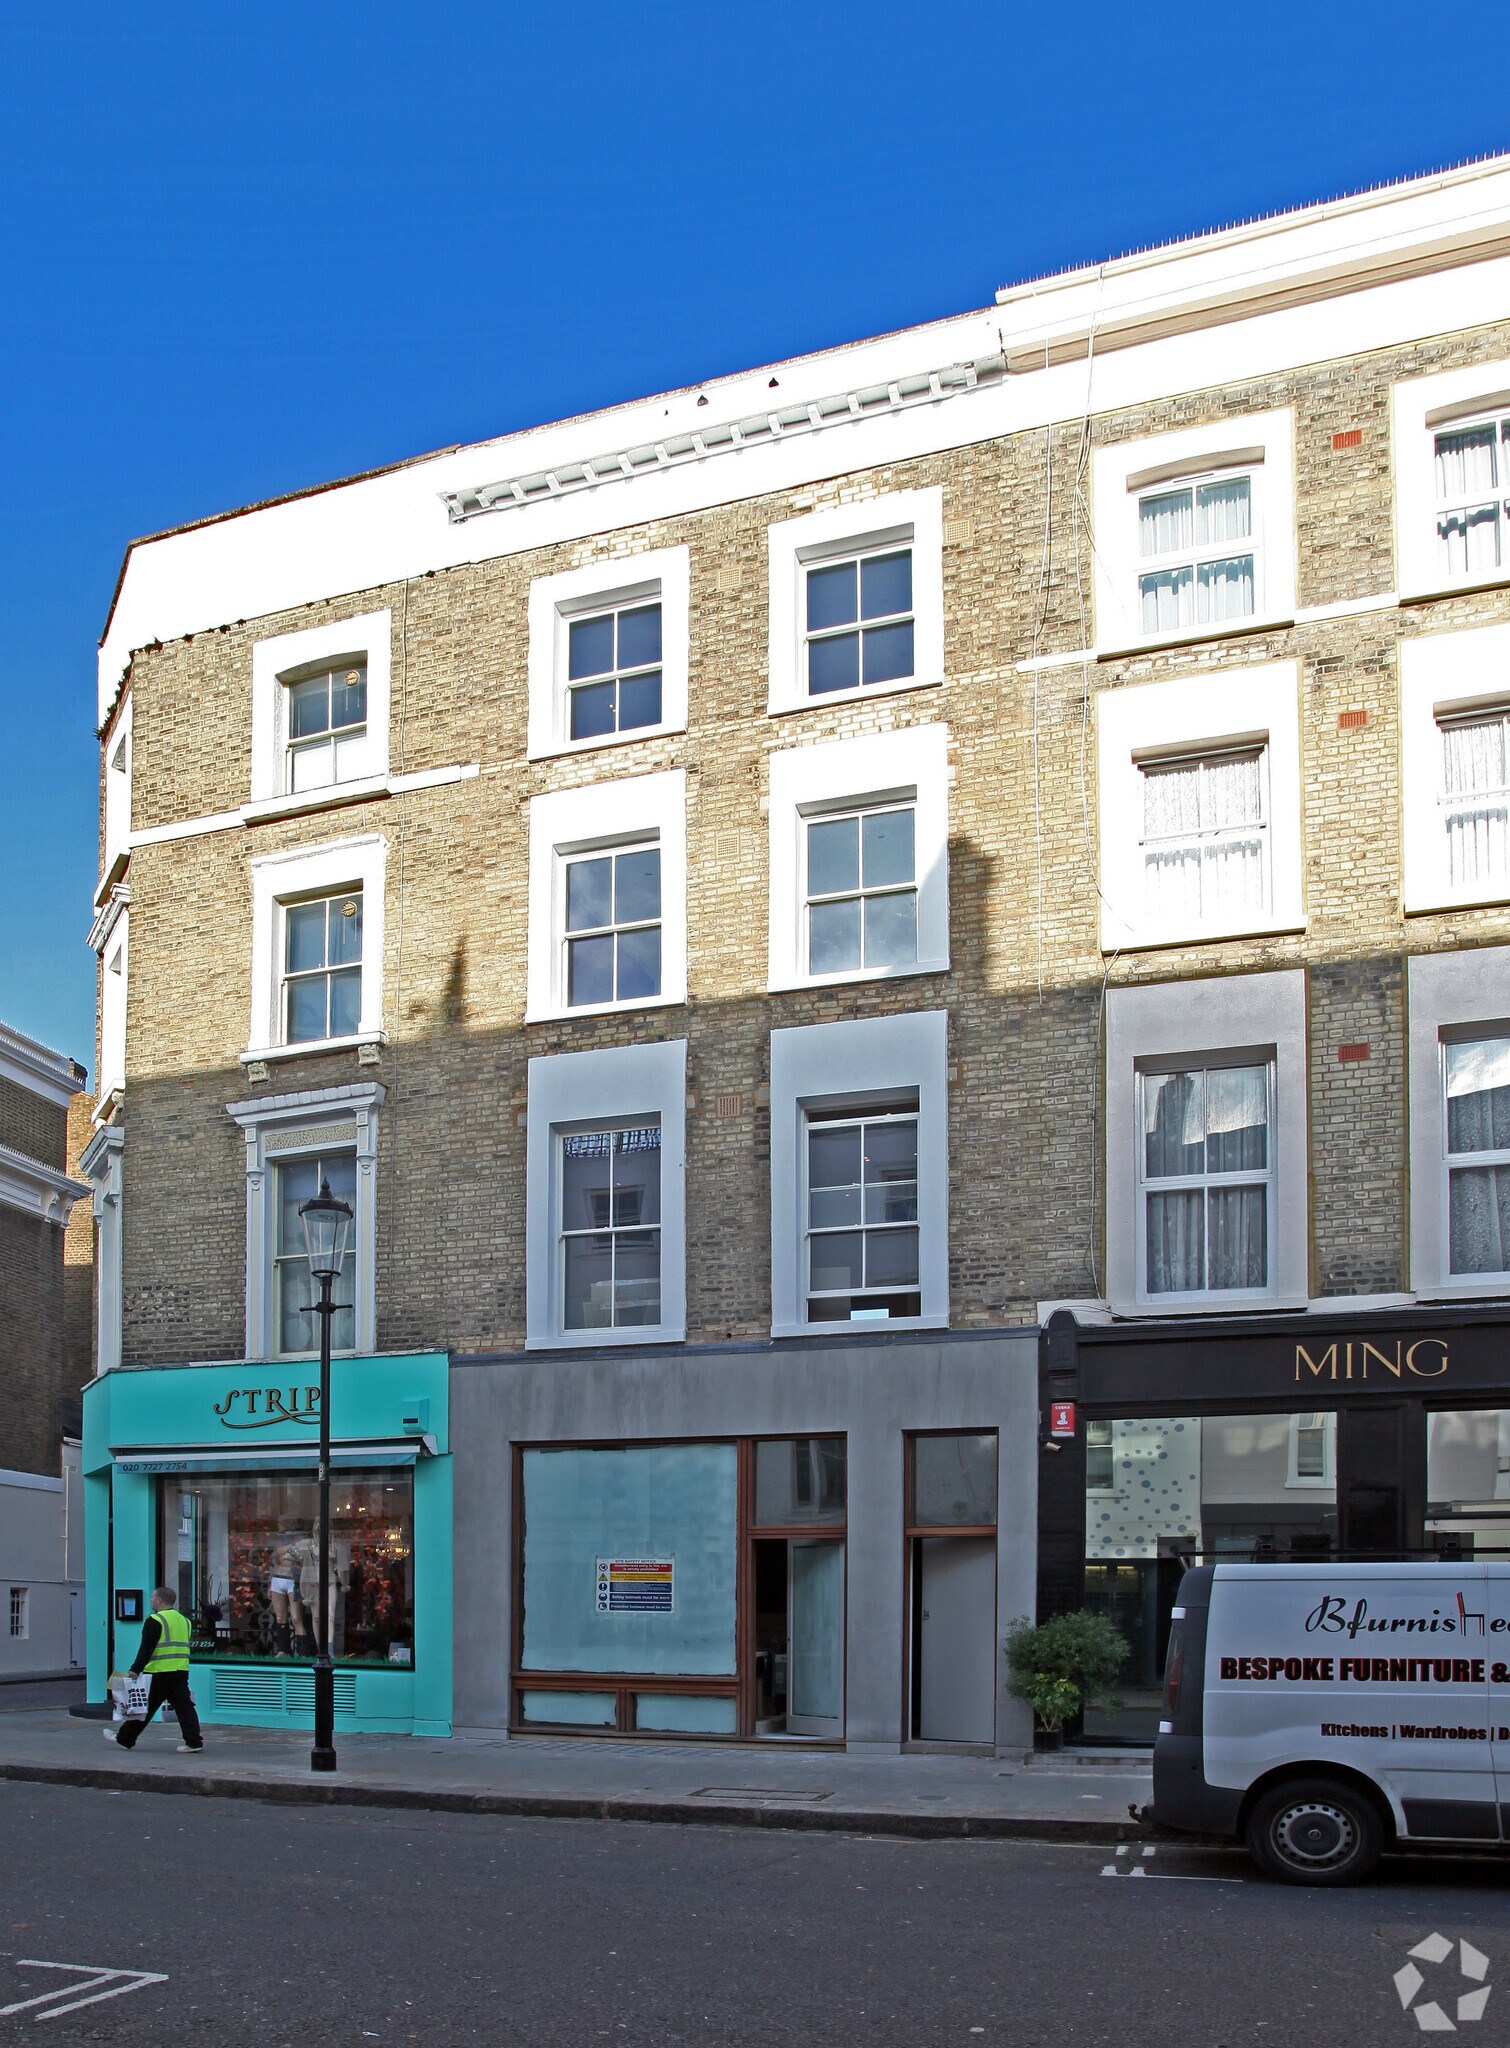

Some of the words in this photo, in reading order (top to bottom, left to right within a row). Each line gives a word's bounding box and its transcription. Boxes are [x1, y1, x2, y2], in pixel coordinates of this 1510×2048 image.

[1295, 1339, 1448, 1380] MING
[213, 1386, 321, 1429] STRIP
[123, 1464, 139, 1472] 020
[143, 1463, 164, 1471] 7727
[166, 1462, 188, 1470] 2754
[1221, 1657, 1334, 1680] BESPOKE
[1340, 1659, 1485, 1682] FURNITURE
[1490, 1662, 1510, 1683] &
[1321, 1723, 1388, 1738] Kitchens
[1399, 1725, 1487, 1741] Wardrobes
[1498, 1727, 1510, 1741] D
